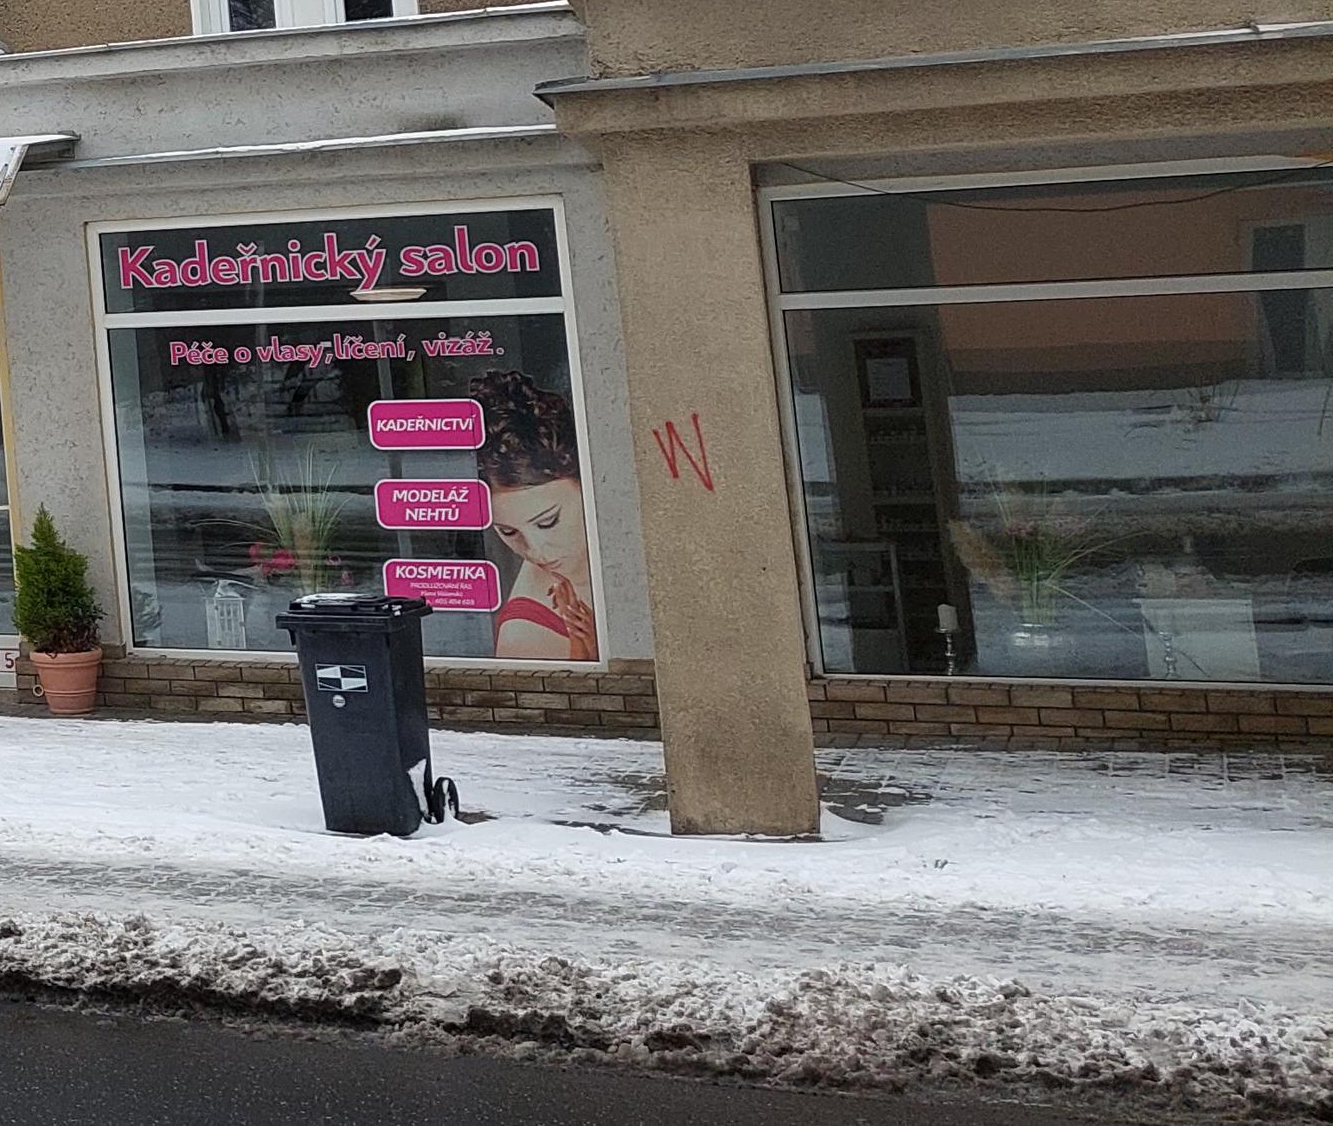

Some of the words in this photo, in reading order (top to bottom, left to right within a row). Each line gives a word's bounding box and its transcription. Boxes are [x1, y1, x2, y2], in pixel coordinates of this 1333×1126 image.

[116, 231, 388, 293] Kadeřnický
[398, 224, 541, 276] salon
[169, 338, 230, 366] Péče
[233, 343, 252, 364] o
[421, 328, 505, 357] vizáž.
[376, 414, 477, 432] KADEŘNICTVÍ
[392, 485, 470, 503] MODELÁŽ
[405, 504, 460, 521] NEHTŮ
[395, 565, 487, 580] KOSMETIKA
